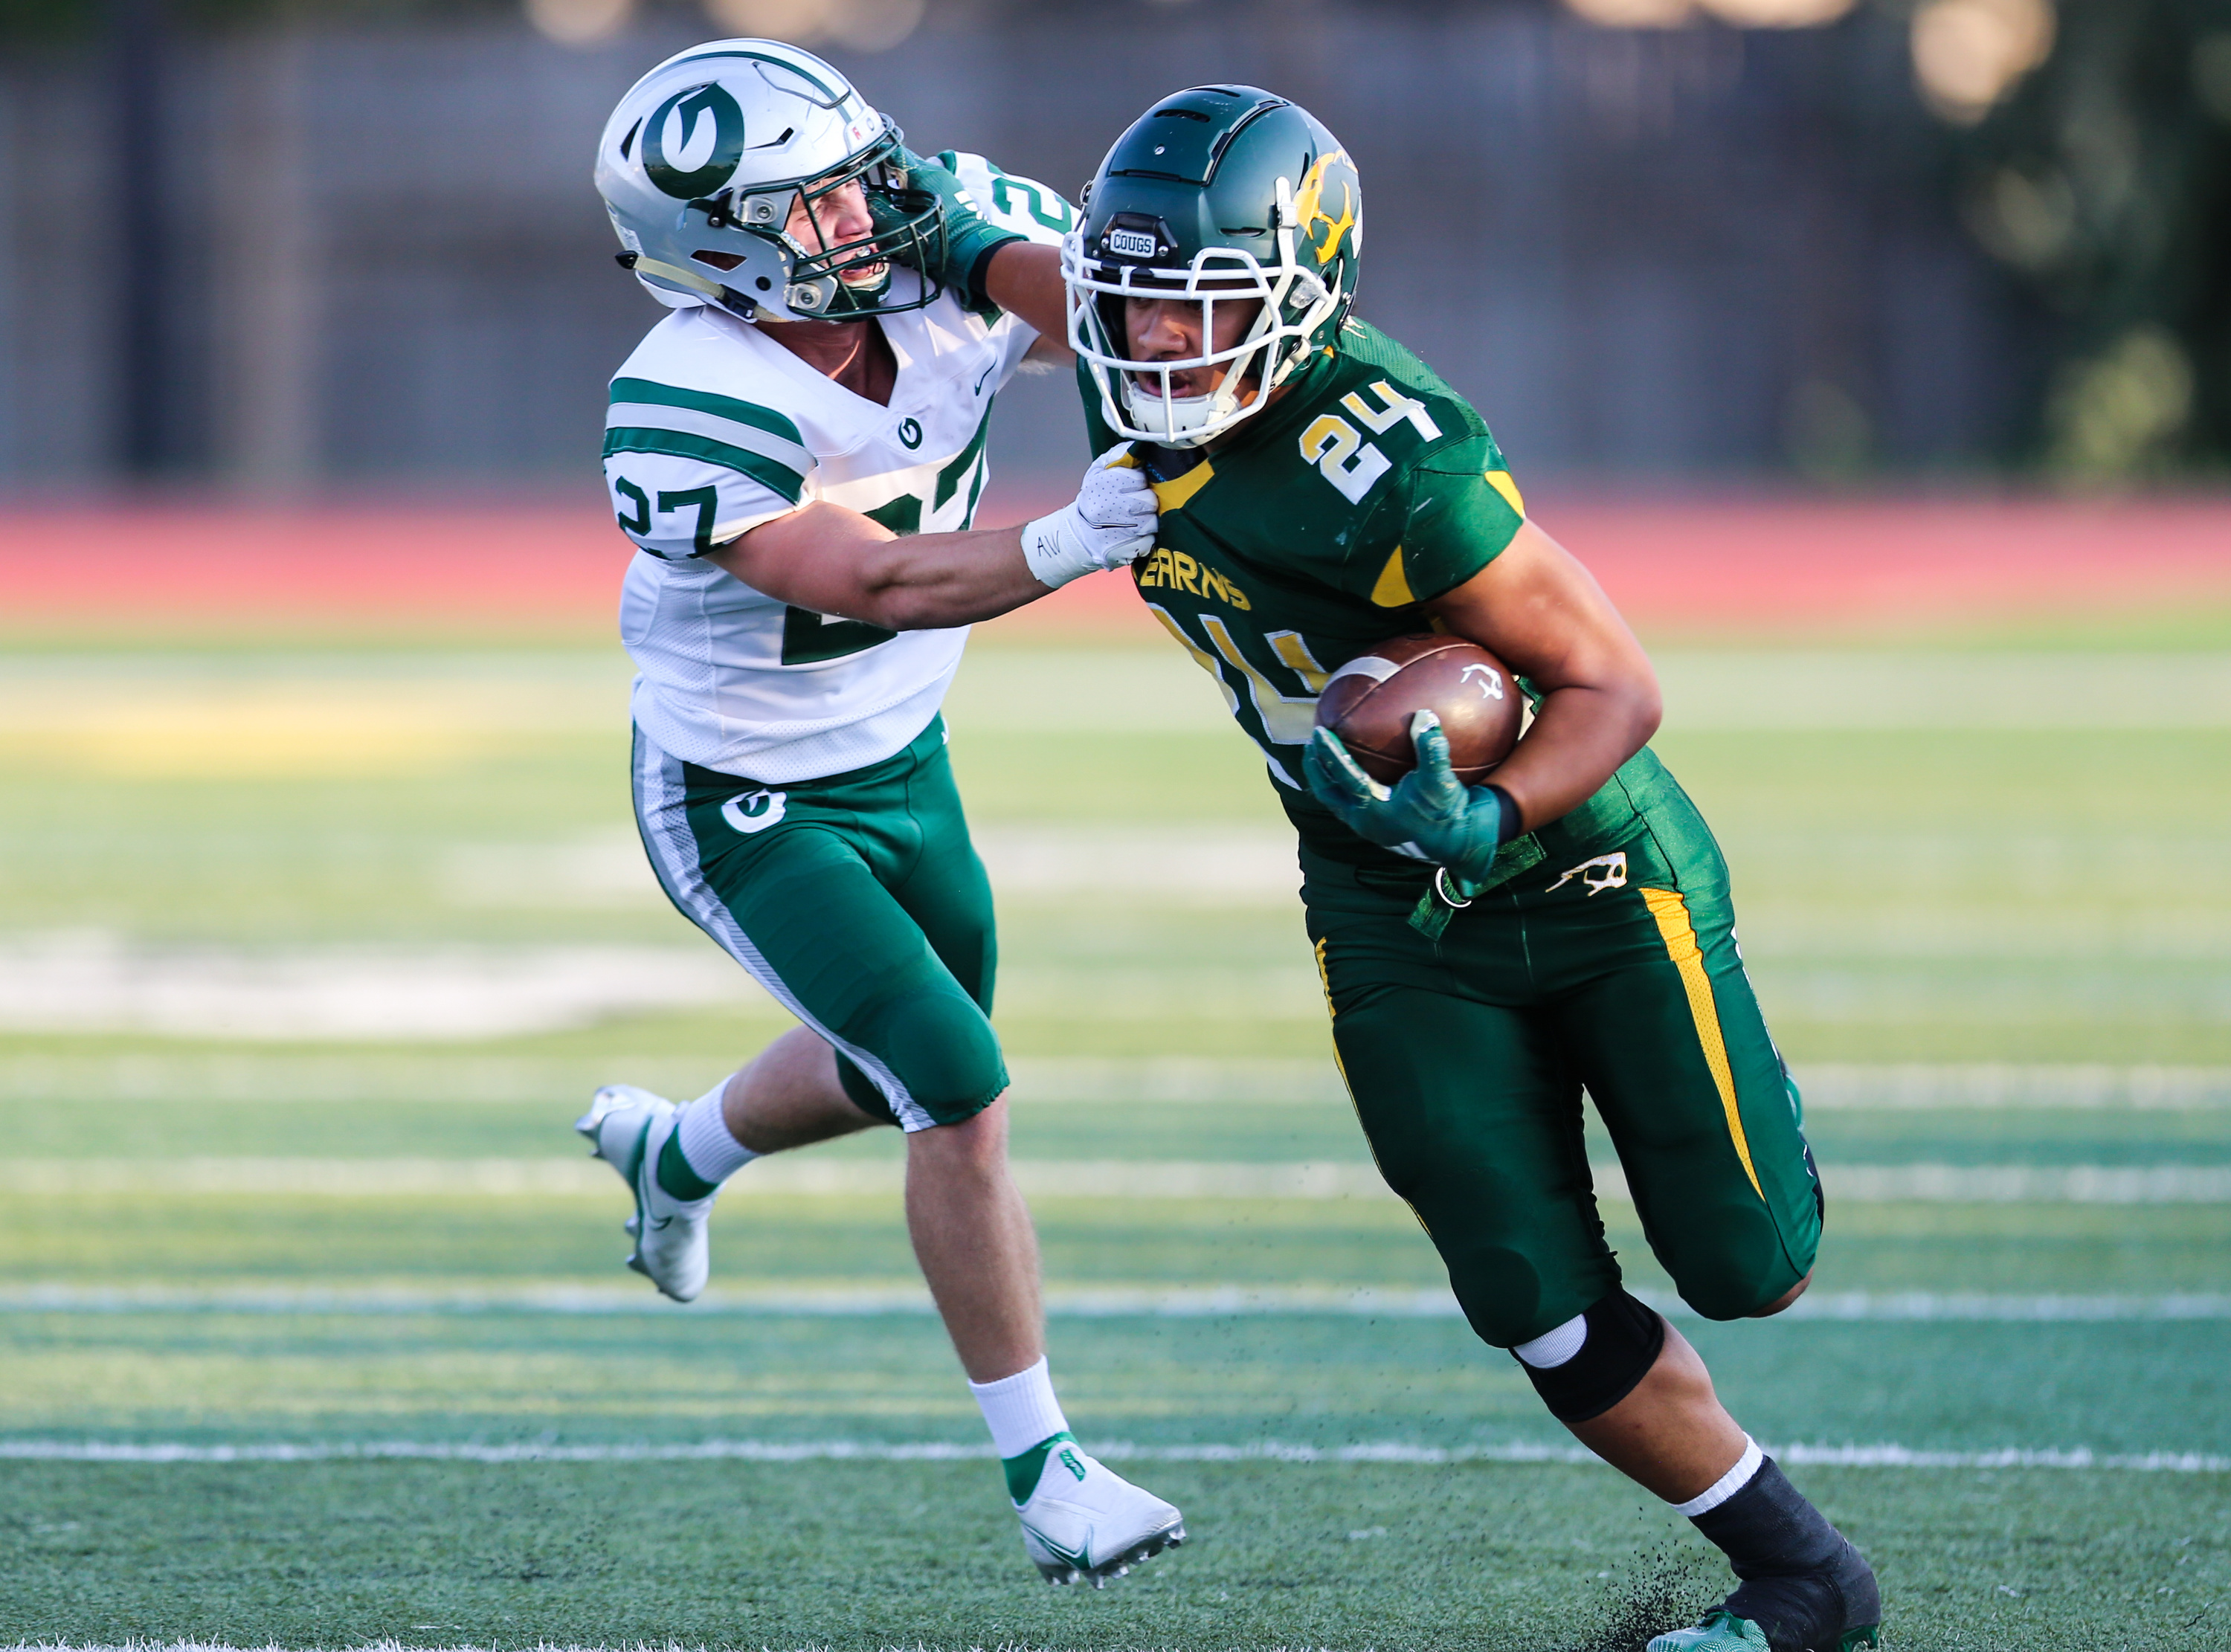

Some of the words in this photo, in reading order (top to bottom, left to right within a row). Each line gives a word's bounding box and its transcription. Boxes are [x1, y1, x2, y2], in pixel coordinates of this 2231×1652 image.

[1114, 234, 1152, 254] COUGS
[1298, 379, 1443, 506] 24
[615, 475, 727, 561] 27
[1037, 530, 1060, 558] AW
[1132, 547, 1252, 611] EARNS
